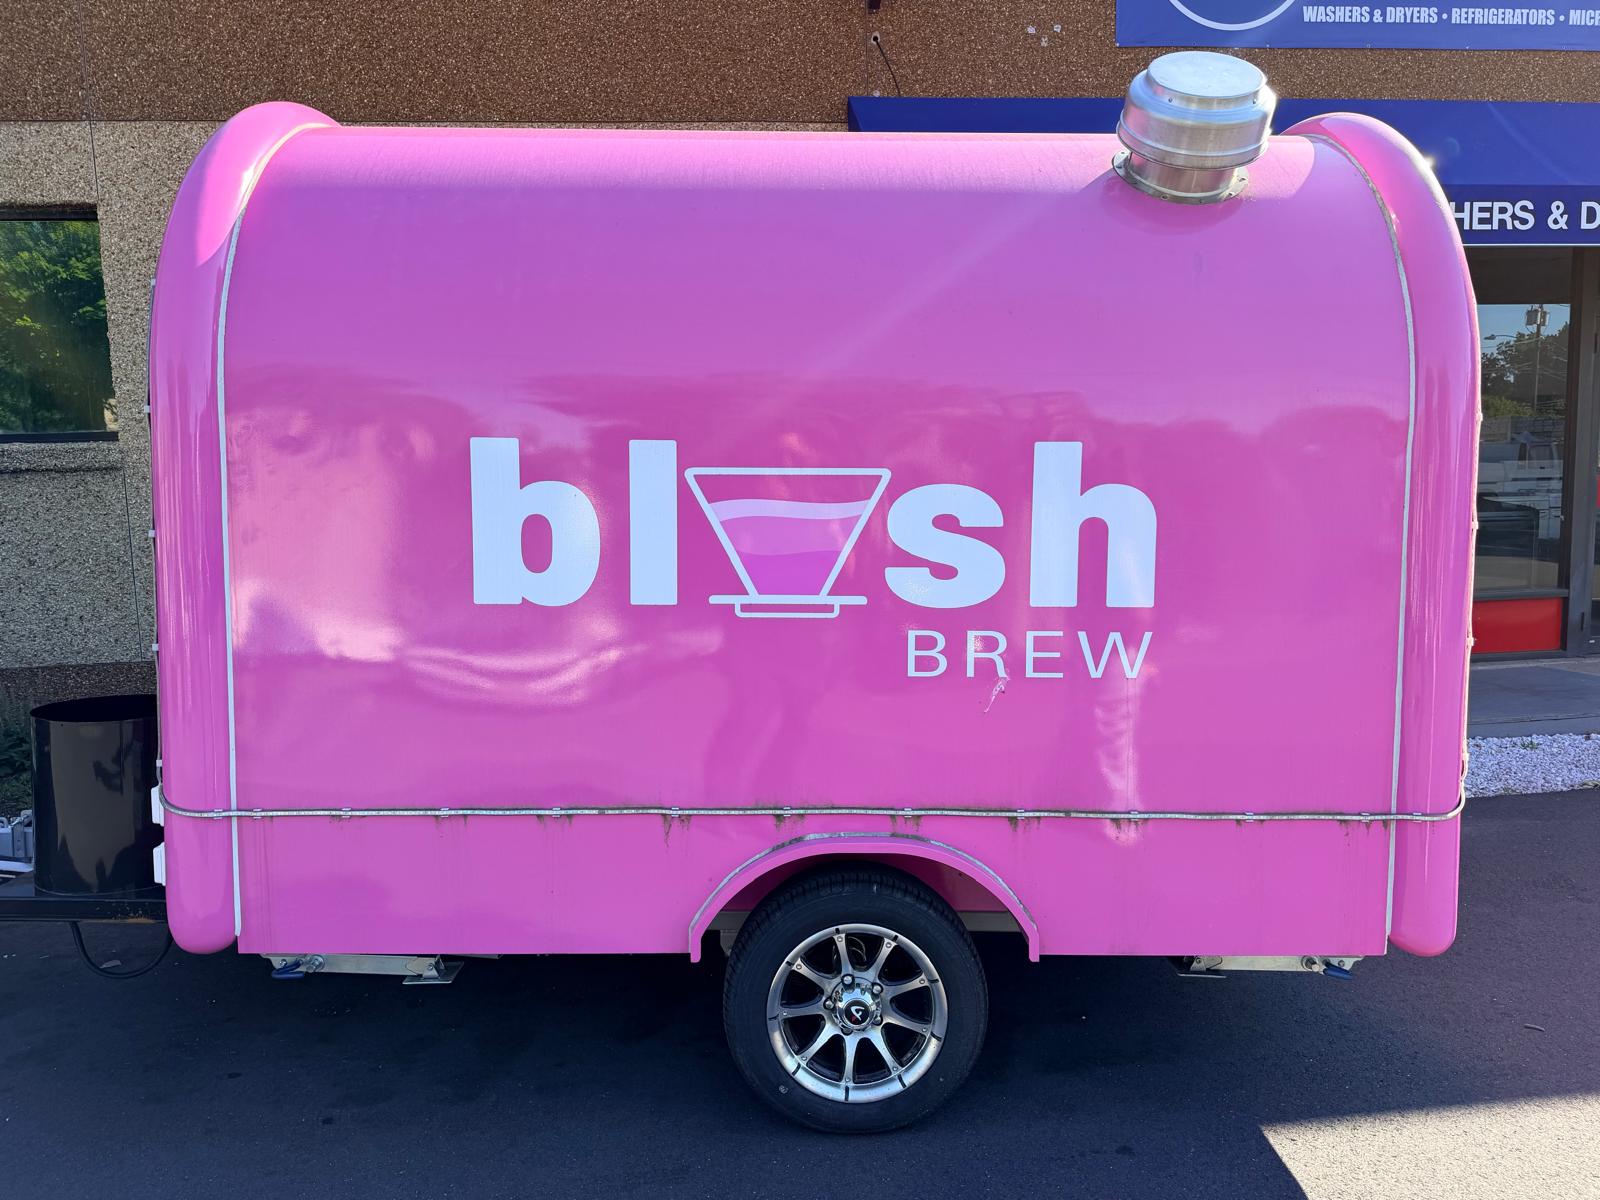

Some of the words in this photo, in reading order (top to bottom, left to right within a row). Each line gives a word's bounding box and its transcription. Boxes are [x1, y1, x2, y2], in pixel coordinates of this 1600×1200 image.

[1303, 6, 1370, 23] WASHERS
[1373, 9, 1383, 23] &
[1386, 7, 1438, 24] DRYERS
[1451, 8, 1555, 25] REFRIGERATORS
[1547, 201, 1569, 230] &
[907, 629, 1153, 679] BREW
